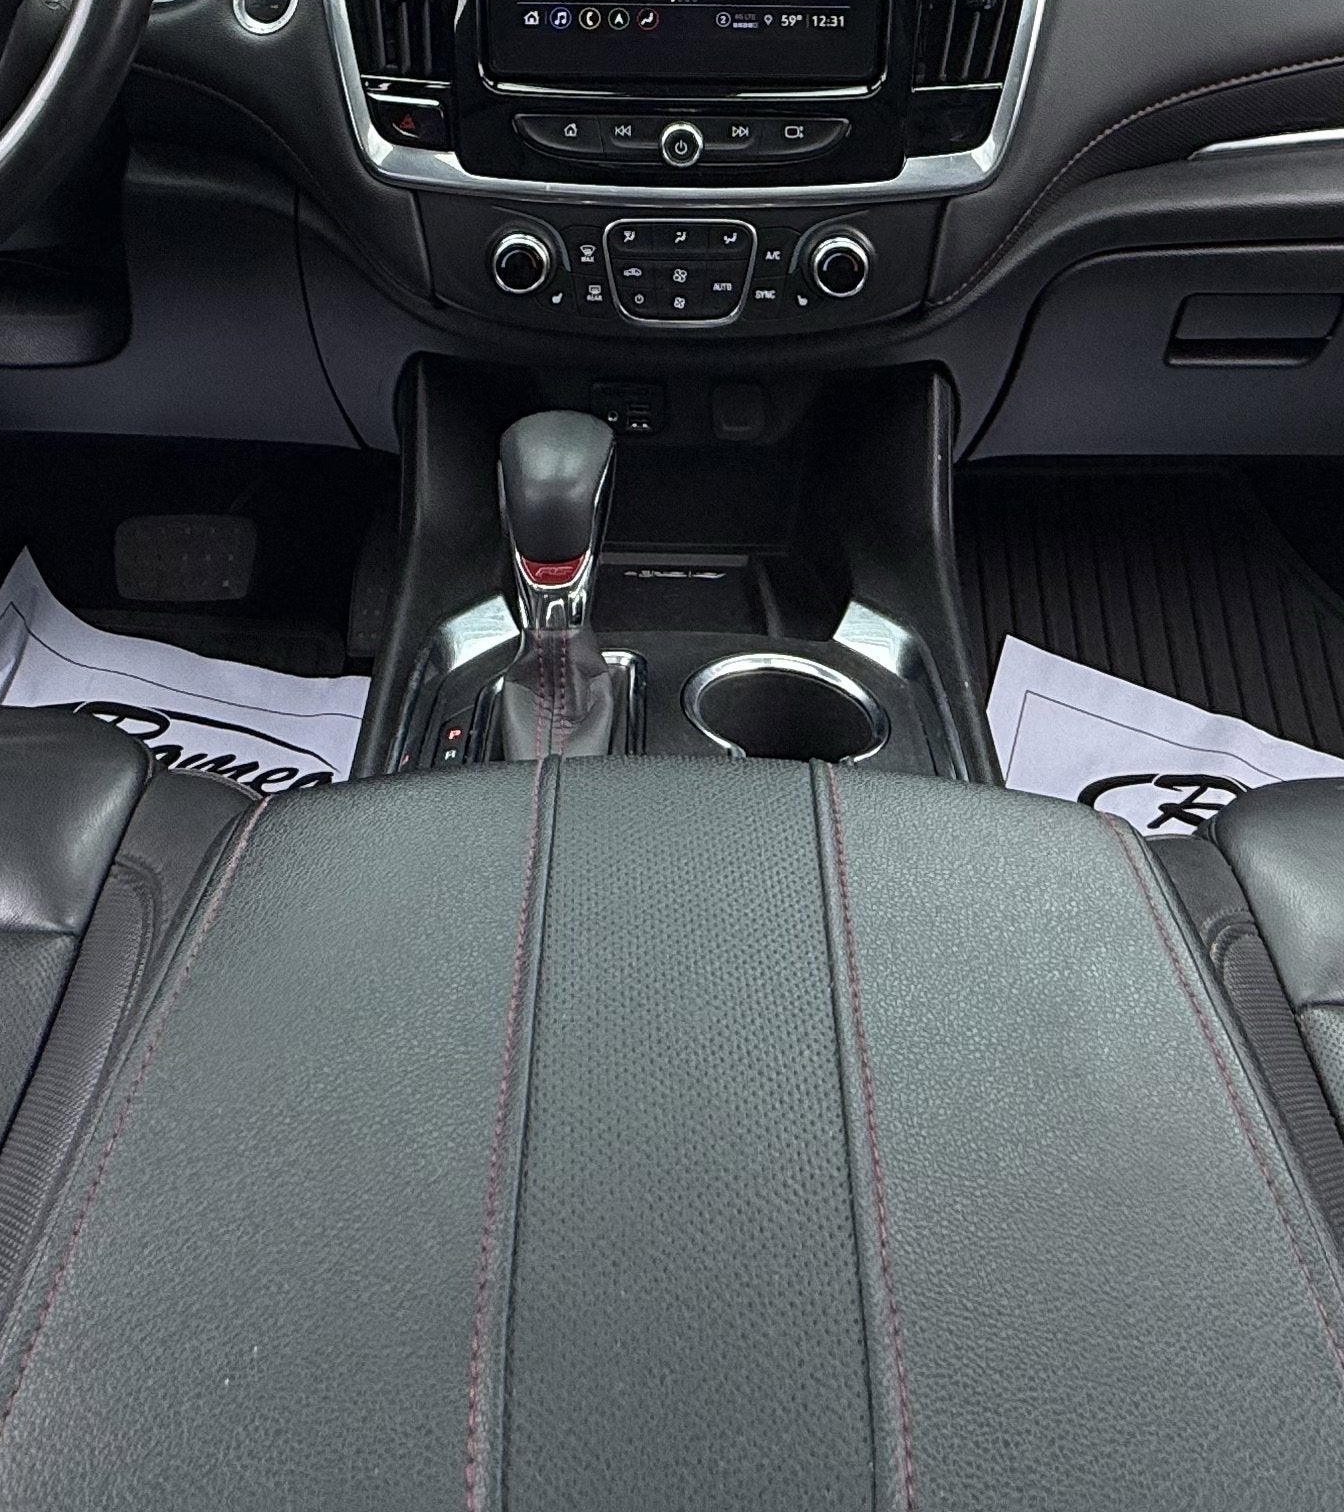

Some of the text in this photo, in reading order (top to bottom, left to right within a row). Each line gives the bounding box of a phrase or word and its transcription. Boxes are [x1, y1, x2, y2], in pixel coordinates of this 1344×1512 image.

[780, 14, 845, 28] 59° 12:31
[765, 251, 781, 261] A/C
[712, 282, 733, 292] AUTO
[755, 290, 777, 299] SYNC
